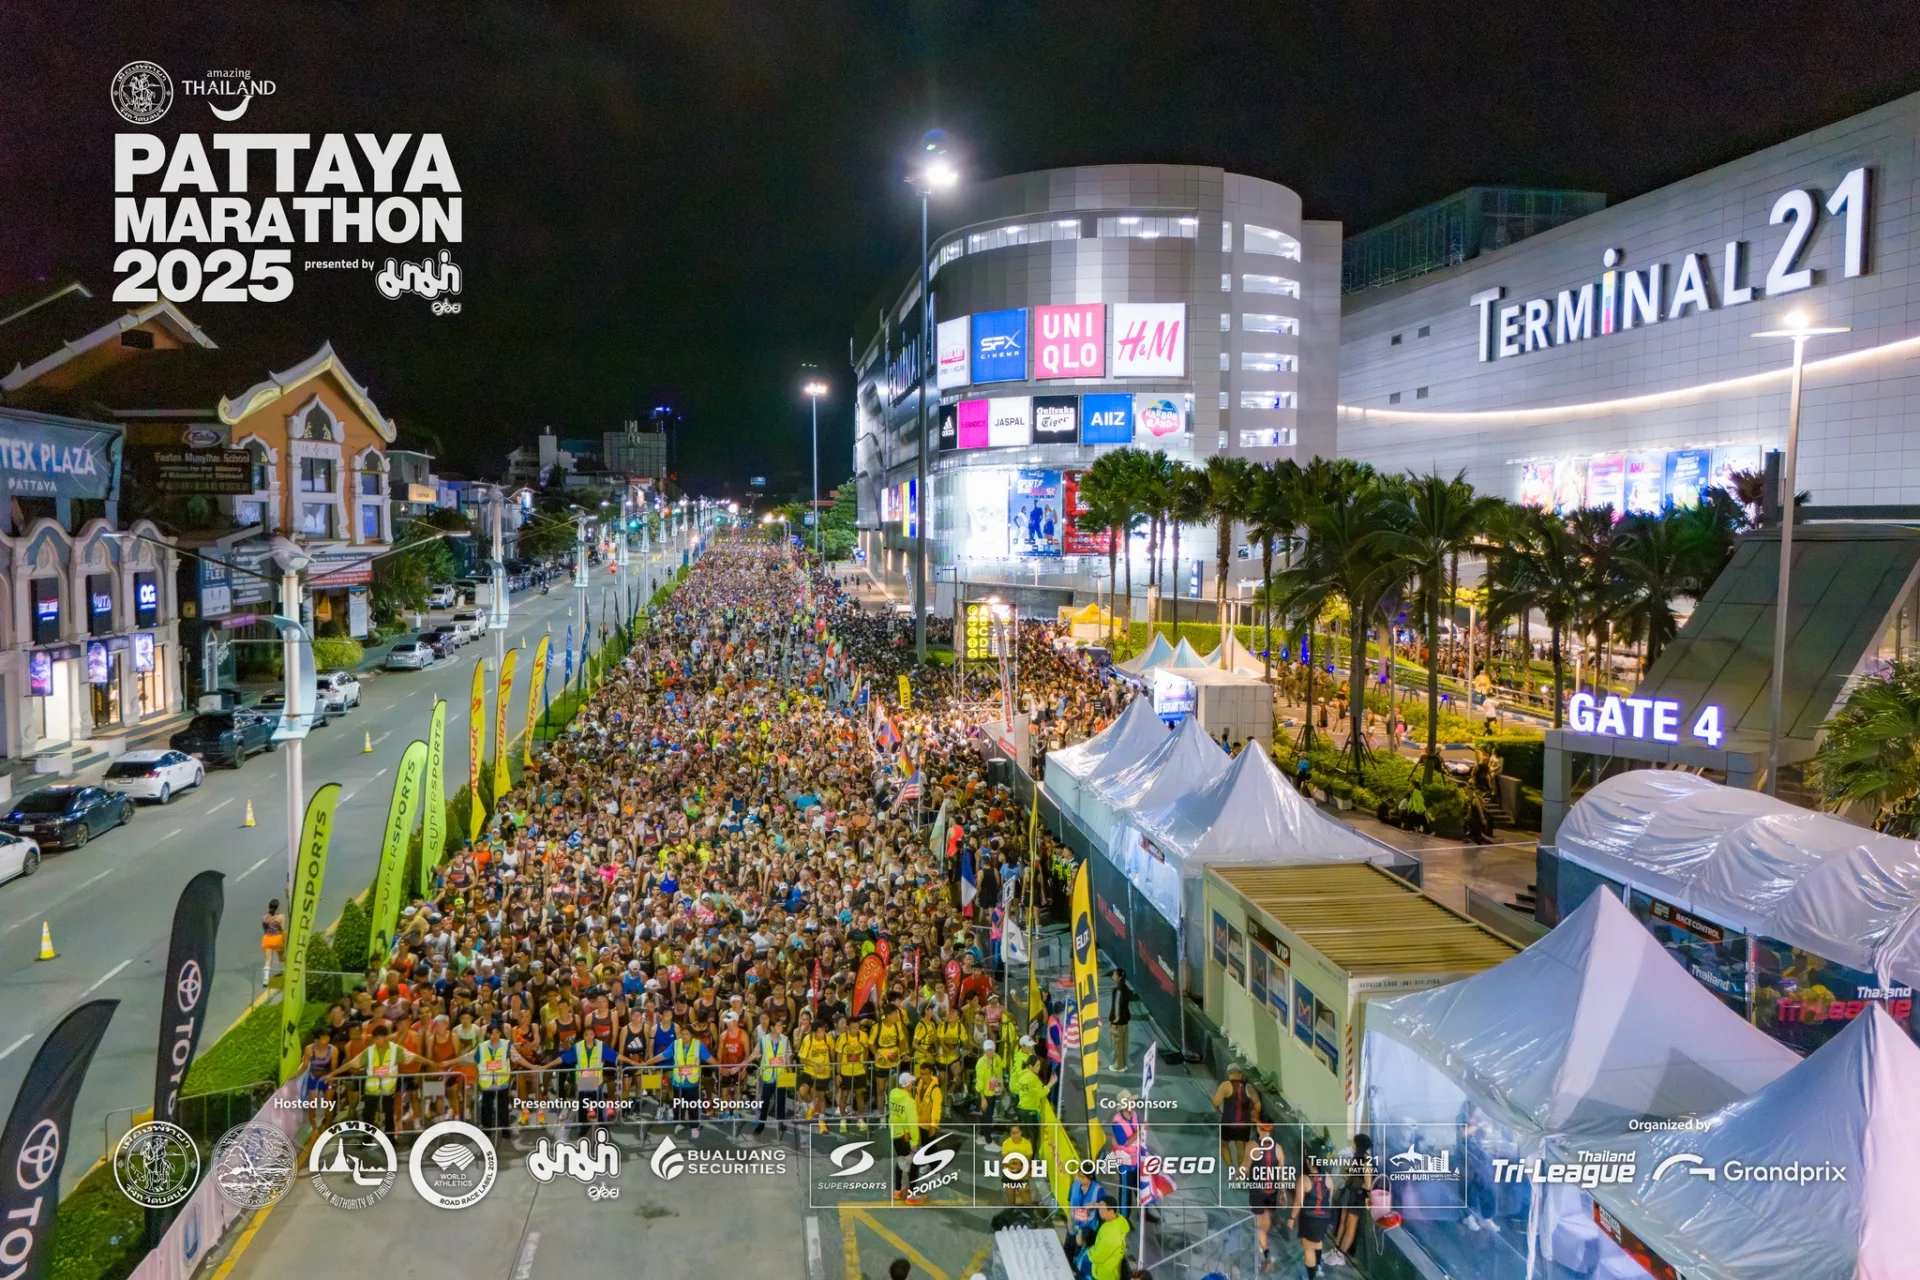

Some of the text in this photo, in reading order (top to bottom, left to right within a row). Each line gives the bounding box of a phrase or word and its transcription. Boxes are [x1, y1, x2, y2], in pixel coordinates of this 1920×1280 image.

[1765, 167, 1871, 296] 21
[1042, 311, 1093, 339] UNI
[980, 331, 1020, 352] SFX
[1117, 320, 1181, 362] H&M
[980, 351, 1019, 360] CINEMA
[1042, 343, 1097, 373] QLO
[1036, 406, 1075, 415] Onitsuka
[1091, 411, 1125, 426] AIIZ
[1145, 409, 1178, 421] HARBOR
[995, 417, 1025, 427] JASPAL
[1041, 416, 1069, 428] Tiger
[0, 437, 97, 476] TEX PLAZA
[8, 478, 57, 492] PATTAYA
[205, 569, 225, 580] FLEX
[979, 627, 988, 637] C
[980, 638, 988, 648] D
[980, 649, 987, 659] E
[1569, 691, 1721, 746] GATE 4
[429, 717, 443, 851] SUPERSPORTS
[380, 759, 417, 915] SUPERSPORTS
[1675, 913, 1720, 940] RACE CONTROL
[1691, 963, 1730, 991] Thailand
[0, 1197, 43, 1280] TO
